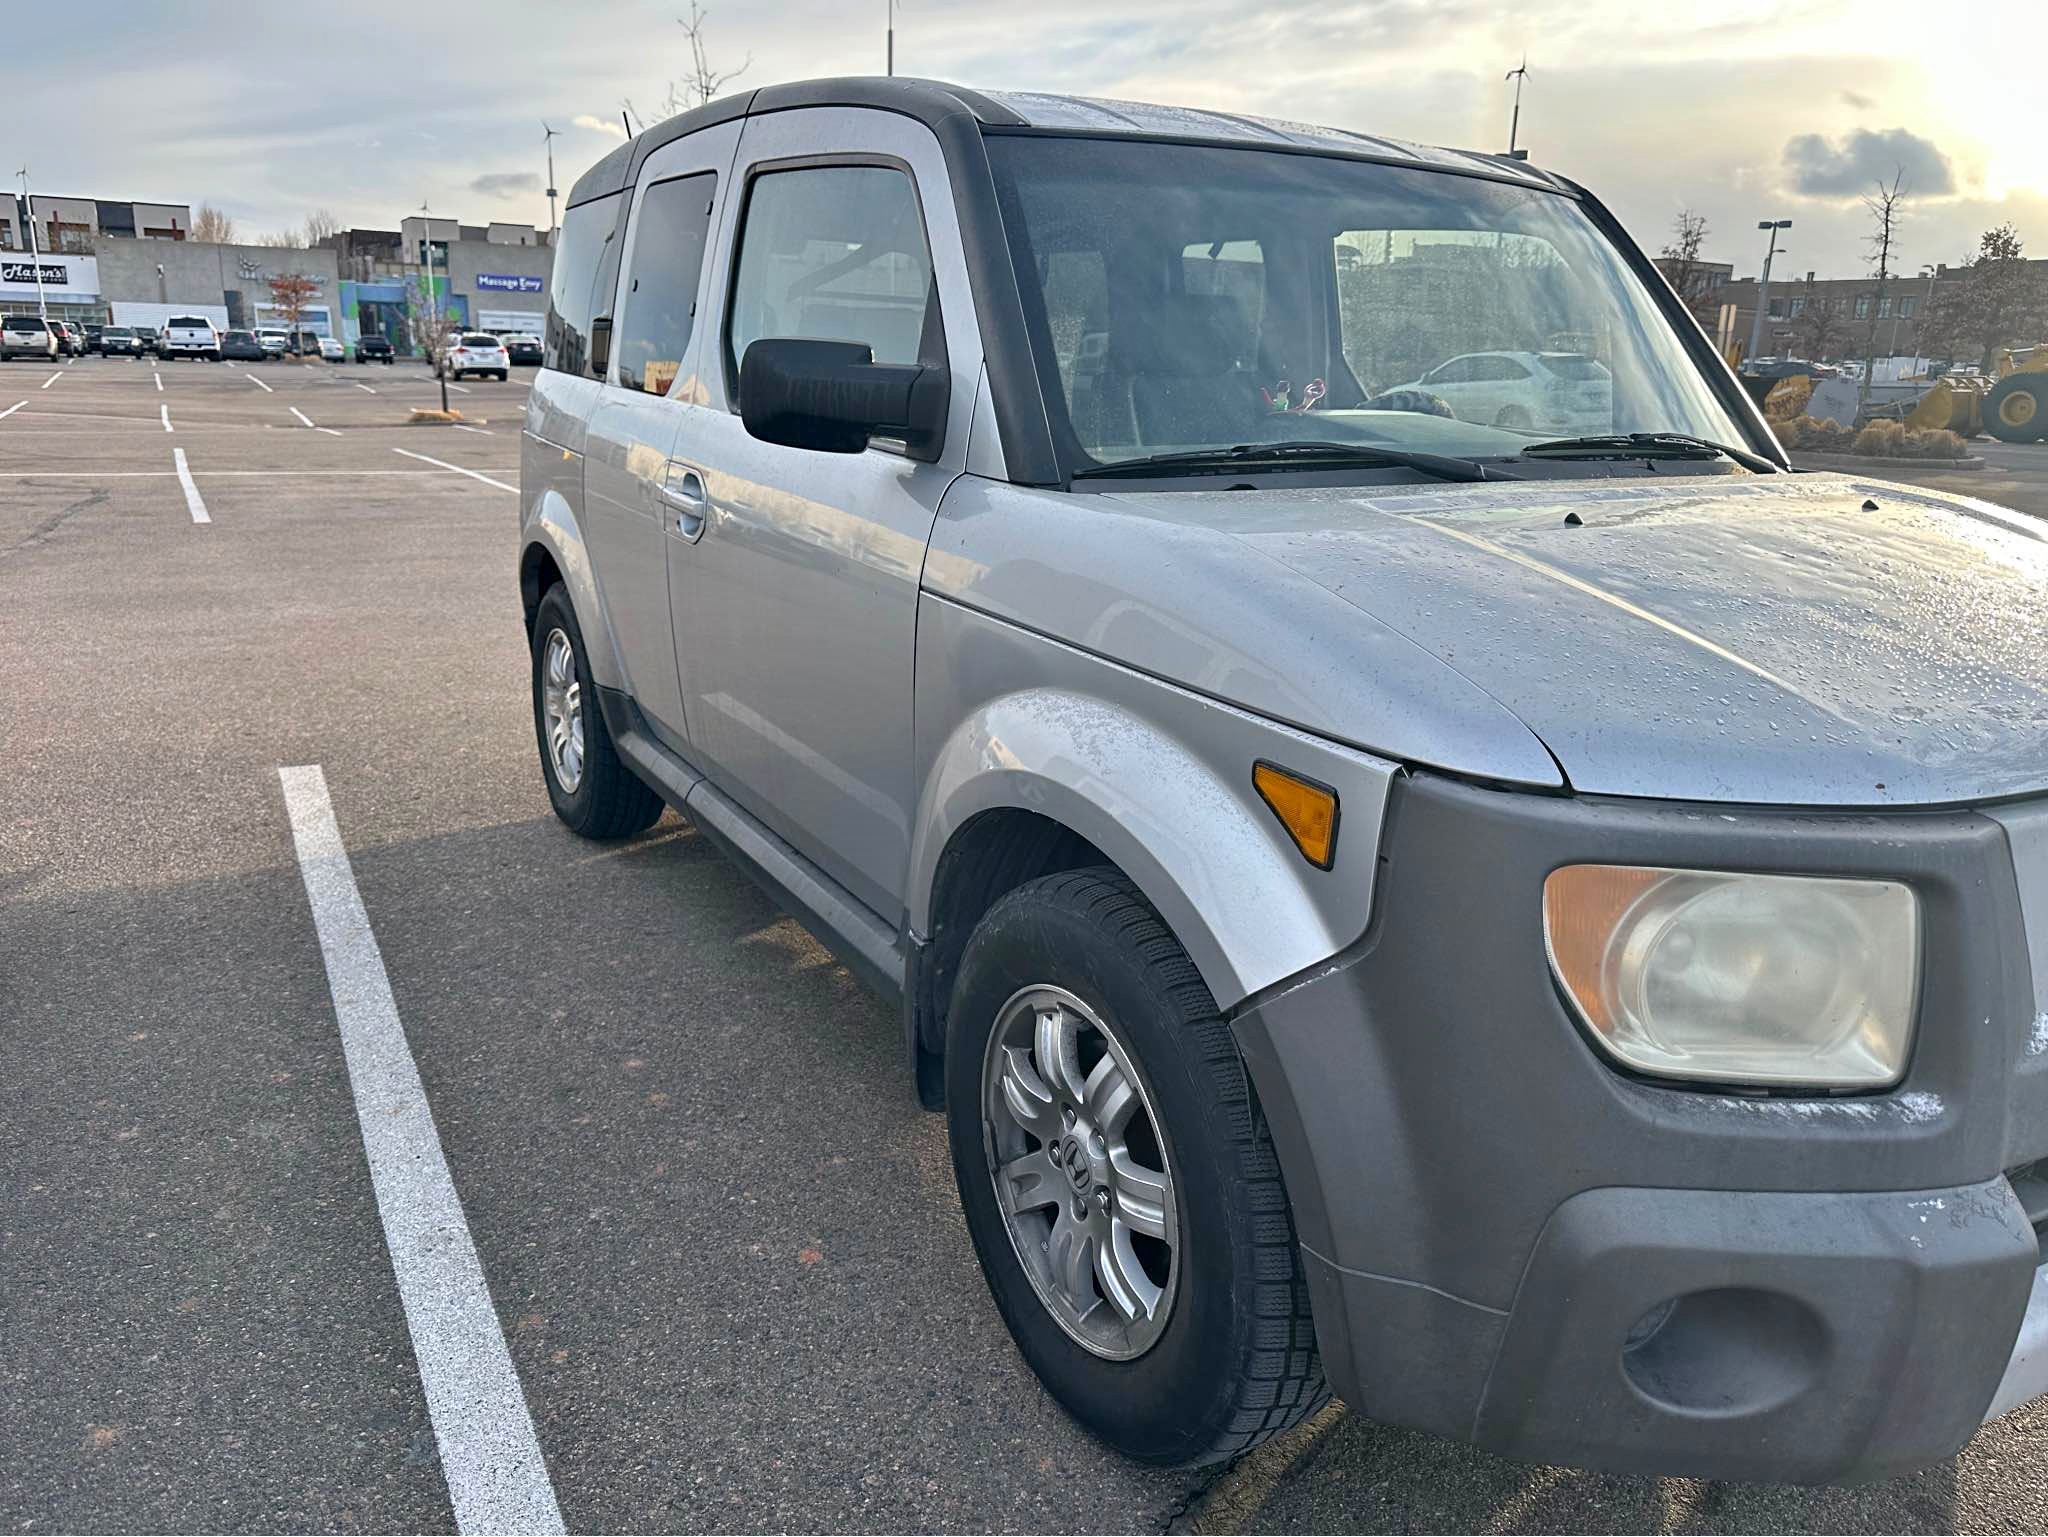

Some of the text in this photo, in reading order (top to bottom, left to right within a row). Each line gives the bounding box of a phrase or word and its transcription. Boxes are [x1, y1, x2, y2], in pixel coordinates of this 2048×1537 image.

[3, 264, 61, 279] Mason's
[479, 276, 540, 291] Massage Envy
